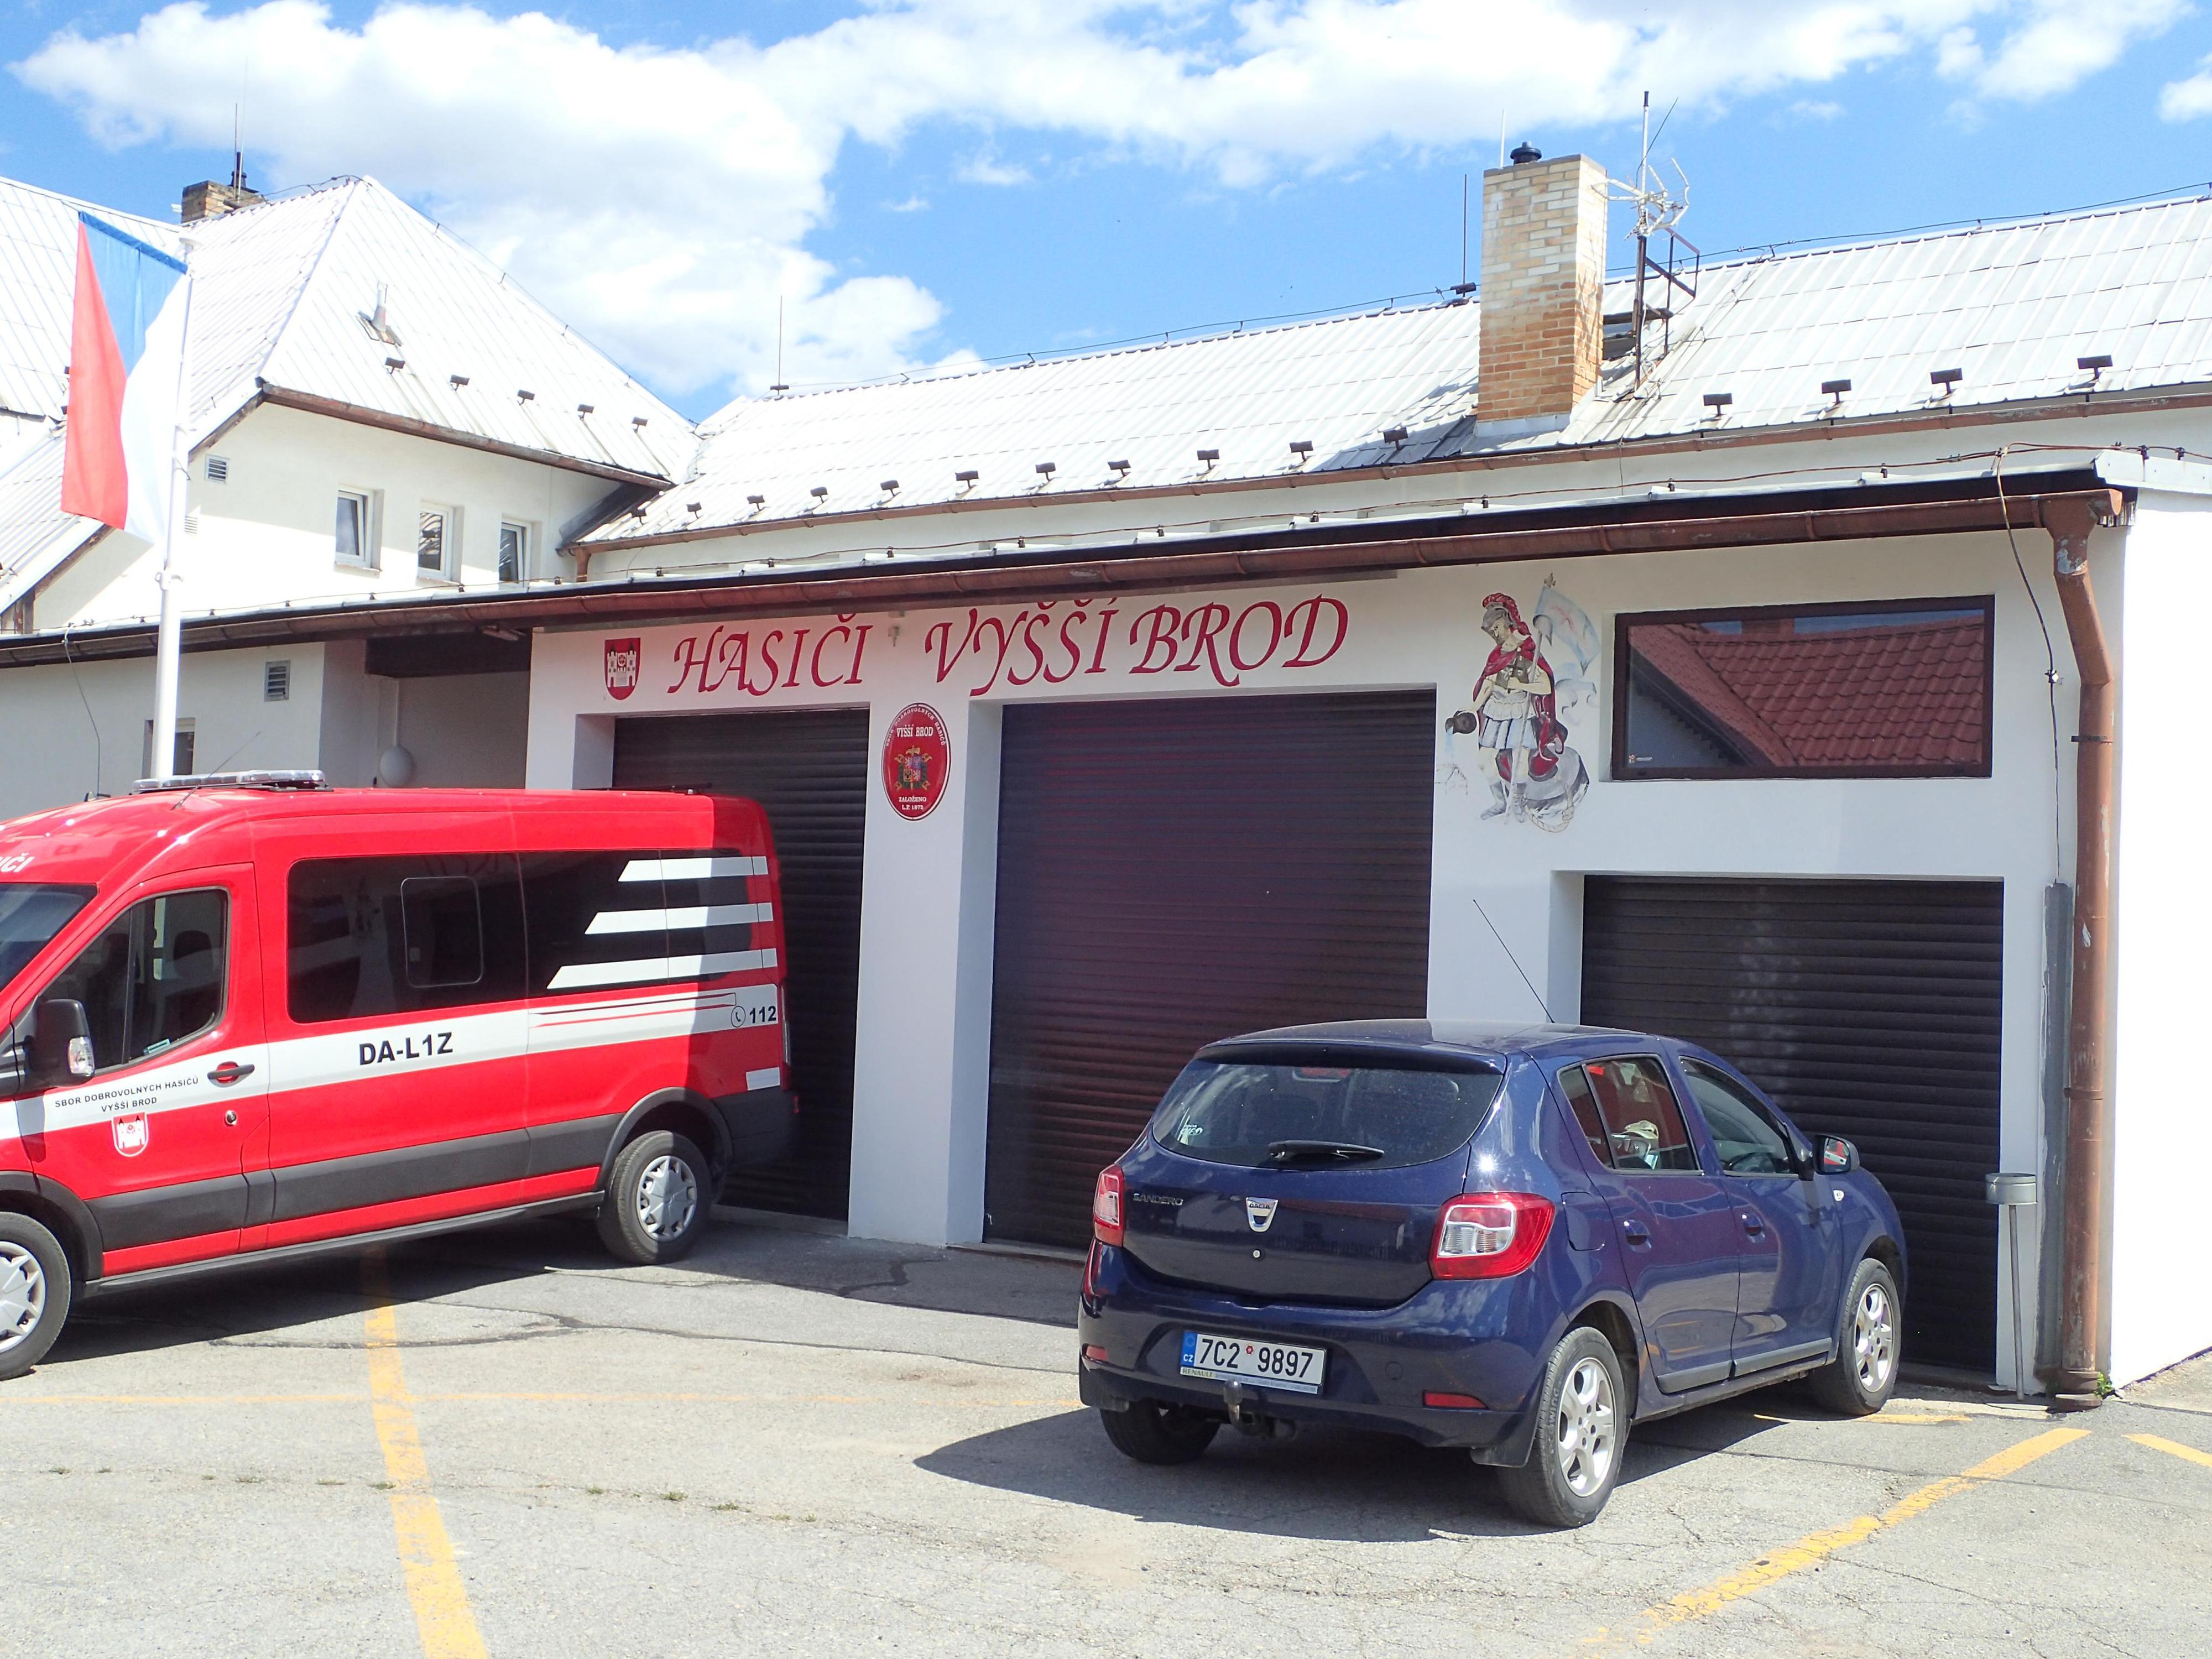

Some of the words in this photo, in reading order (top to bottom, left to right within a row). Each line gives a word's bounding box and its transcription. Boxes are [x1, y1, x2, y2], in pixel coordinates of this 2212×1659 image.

[667, 613, 873, 696] HASIČI
[925, 598, 1120, 697] VYŠŠÍ
[1129, 593, 1349, 687] BROD
[915, 726, 933, 737] BROD
[0, 852, 35, 873] IČI
[749, 1005, 777, 1024] 112
[359, 1031, 453, 1066] DA-L1Z
[55, 1097, 82, 1108] SBOR
[84, 1084, 162, 1103] DOBROVOLNÝCH
[165, 1076, 199, 1089] HASIČŮ
[101, 1100, 129, 1113] VYŠŠÍ
[132, 1097, 158, 1107] BROD
[1133, 1193, 1183, 1206] SANDERO
[1183, 1354, 1193, 1363] CZ
[1199, 1338, 1240, 1369] 7C2
[1257, 1347, 1313, 1378] 9897
[1182, 1367, 1214, 1378] RENAULT
